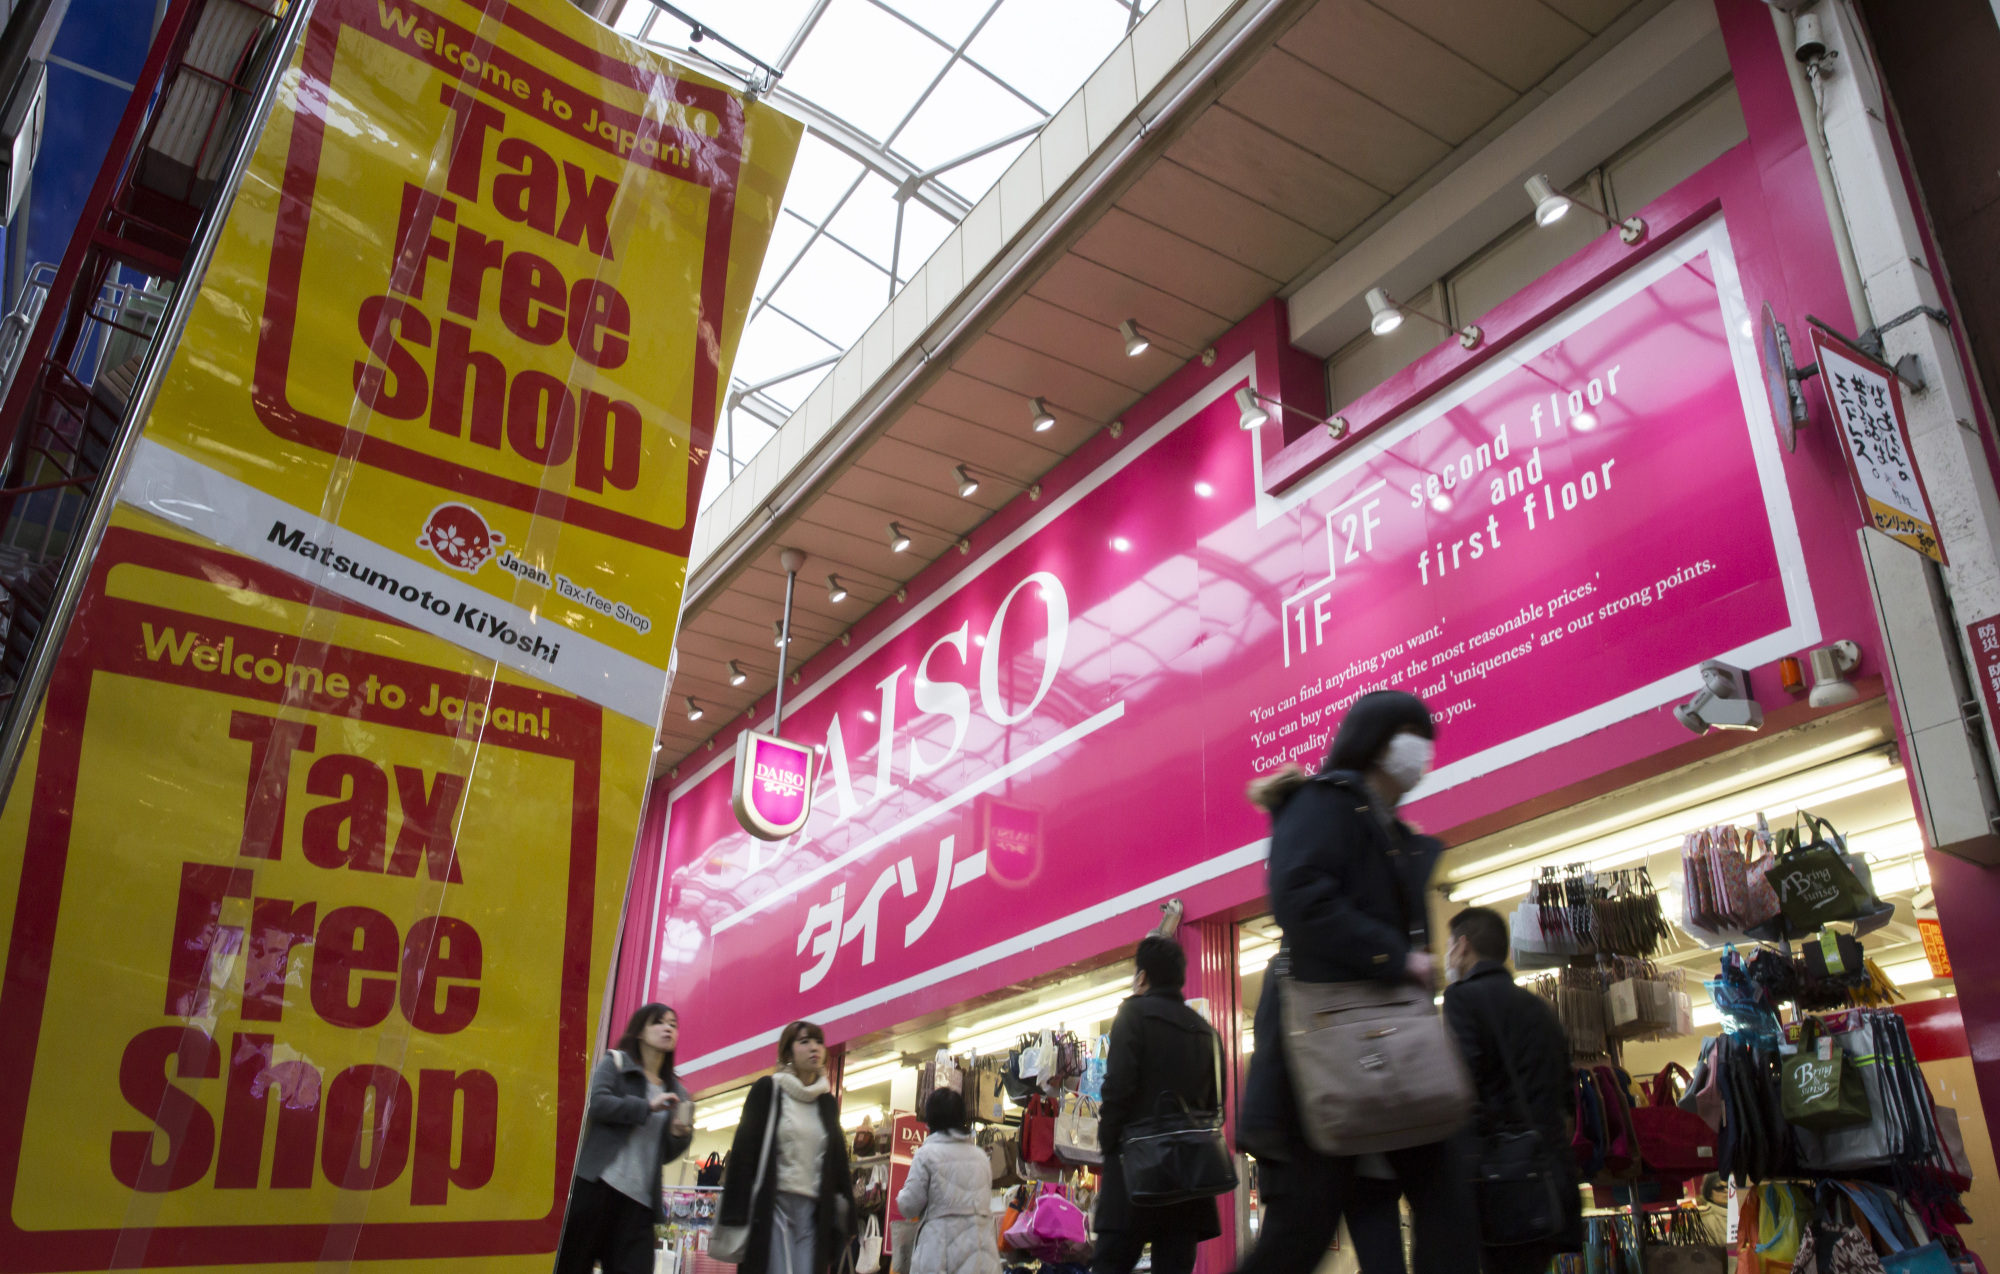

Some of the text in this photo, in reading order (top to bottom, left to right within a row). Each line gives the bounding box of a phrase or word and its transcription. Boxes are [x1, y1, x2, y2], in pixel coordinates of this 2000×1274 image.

[378, 0, 690, 168] Welcome to Japan!
[440, 83, 619, 262] Tax
[389, 182, 631, 370] Free
[352, 294, 643, 495] Shop
[1410, 364, 1620, 508] second floor
[1342, 498, 1380, 564] 2F
[1418, 458, 1615, 586] first floor
[1490, 446, 1543, 505] and
[1875, 512, 1915, 534] センリュウ
[500, 554, 650, 632] Japan. Tax-free Shop
[1294, 592, 1331, 654] 1F
[141, 621, 550, 740] Welcome to Japan!
[1250, 617, 1446, 724] 'You can find anything you want.'
[1251, 731, 1276, 749] 'You
[1279, 719, 1298, 737] can
[1301, 708, 1322, 731] buy
[1325, 679, 1388, 716] everything
[1390, 669, 1404, 686] at
[1407, 657, 1428, 678] the
[1432, 641, 1465, 667] most
[1469, 601, 1544, 650] reasonable
[1547, 571, 1600, 619] prices.'
[1252, 751, 1286, 773] 'Good
[1422, 674, 1447, 700] and
[1449, 633, 1535, 685] 'uniqueness'
[1540, 626, 1563, 647] are
[1567, 611, 1594, 635] our
[1599, 586, 1652, 619] strong
[1655, 558, 1717, 600] points.
[229, 709, 467, 885] Tax
[756, 763, 804, 787] DAISO
[1304, 762, 1318, 777] &
[1430, 711, 1443, 726] to
[1446, 698, 1476, 724] you.
[796, 834, 987, 993] ダイソー
[1785, 868, 1831, 896] Bring
[1803, 885, 1838, 903] sunset
[162, 861, 483, 1034] Free
[108, 1026, 498, 1206] Shop
[1794, 1062, 1832, 1088] Bring
